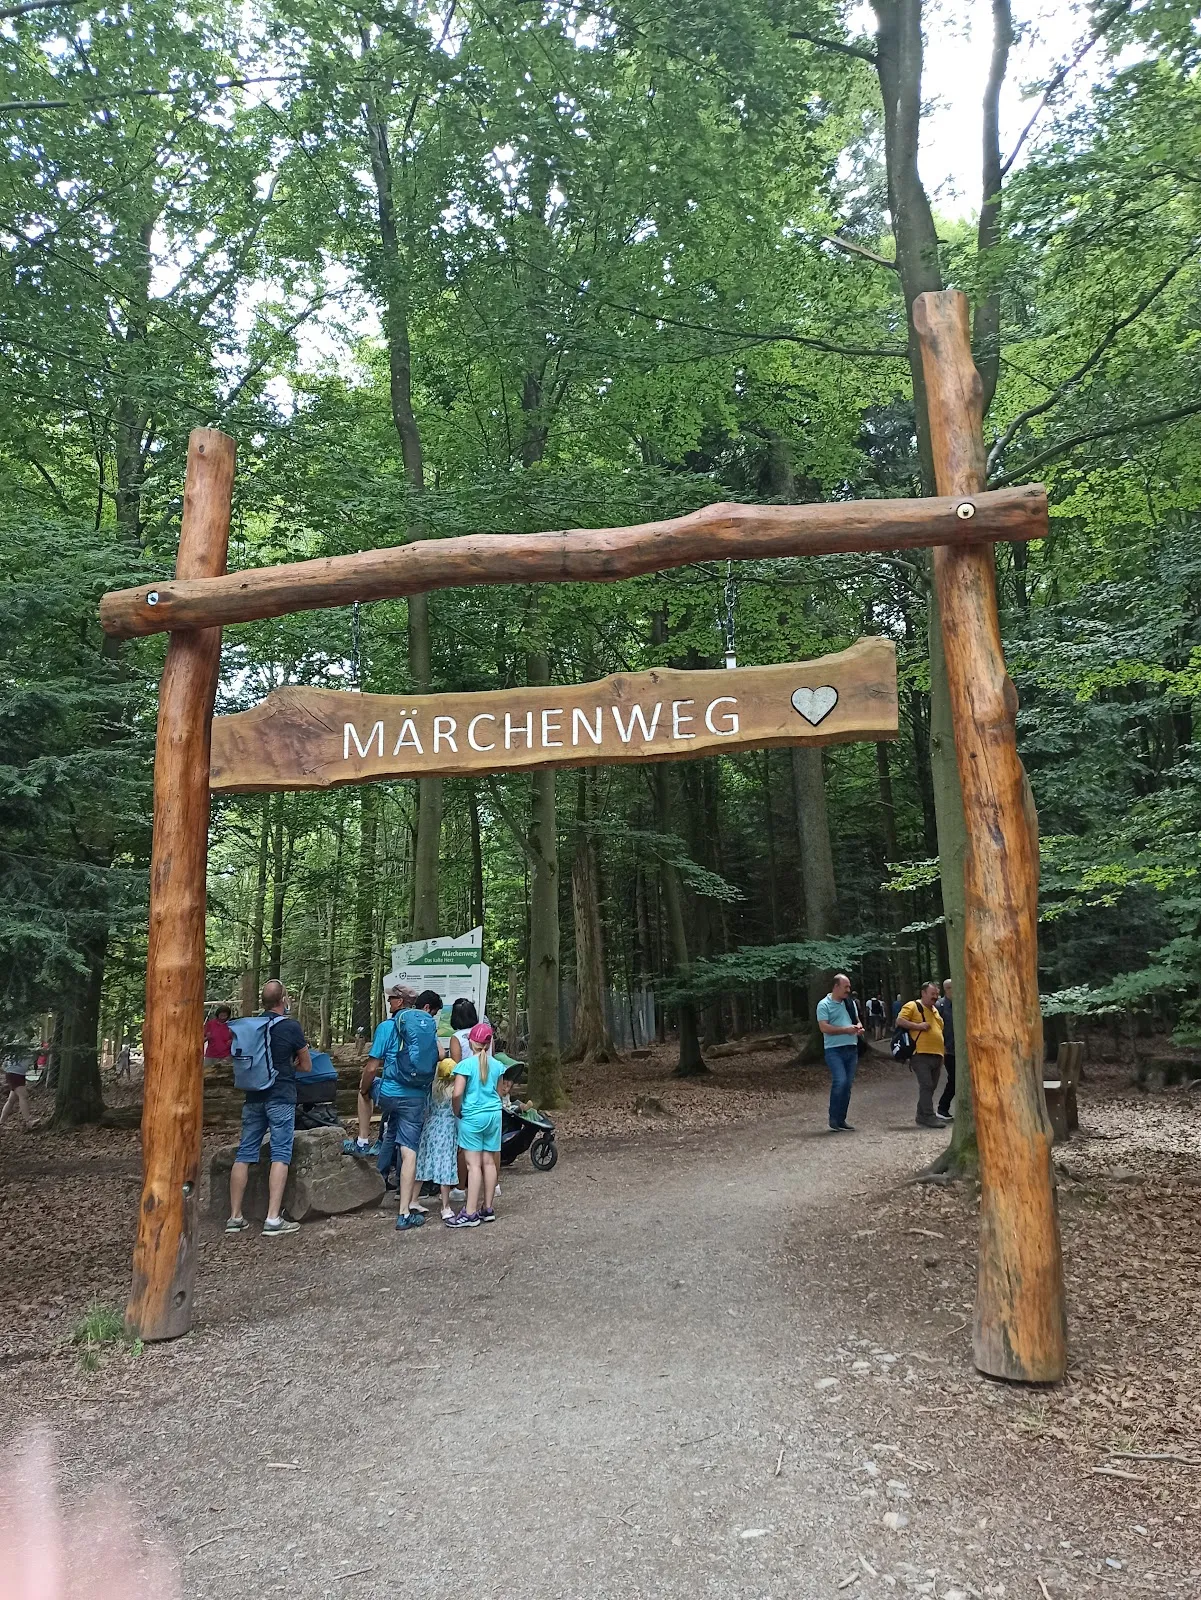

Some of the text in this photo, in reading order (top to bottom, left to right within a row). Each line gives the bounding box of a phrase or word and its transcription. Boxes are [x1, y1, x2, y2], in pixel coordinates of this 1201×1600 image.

[342, 696, 740, 760] MÄRCHENWEG
[470, 934, 474, 945] 1
[441, 950, 478, 959] Märchenweg
